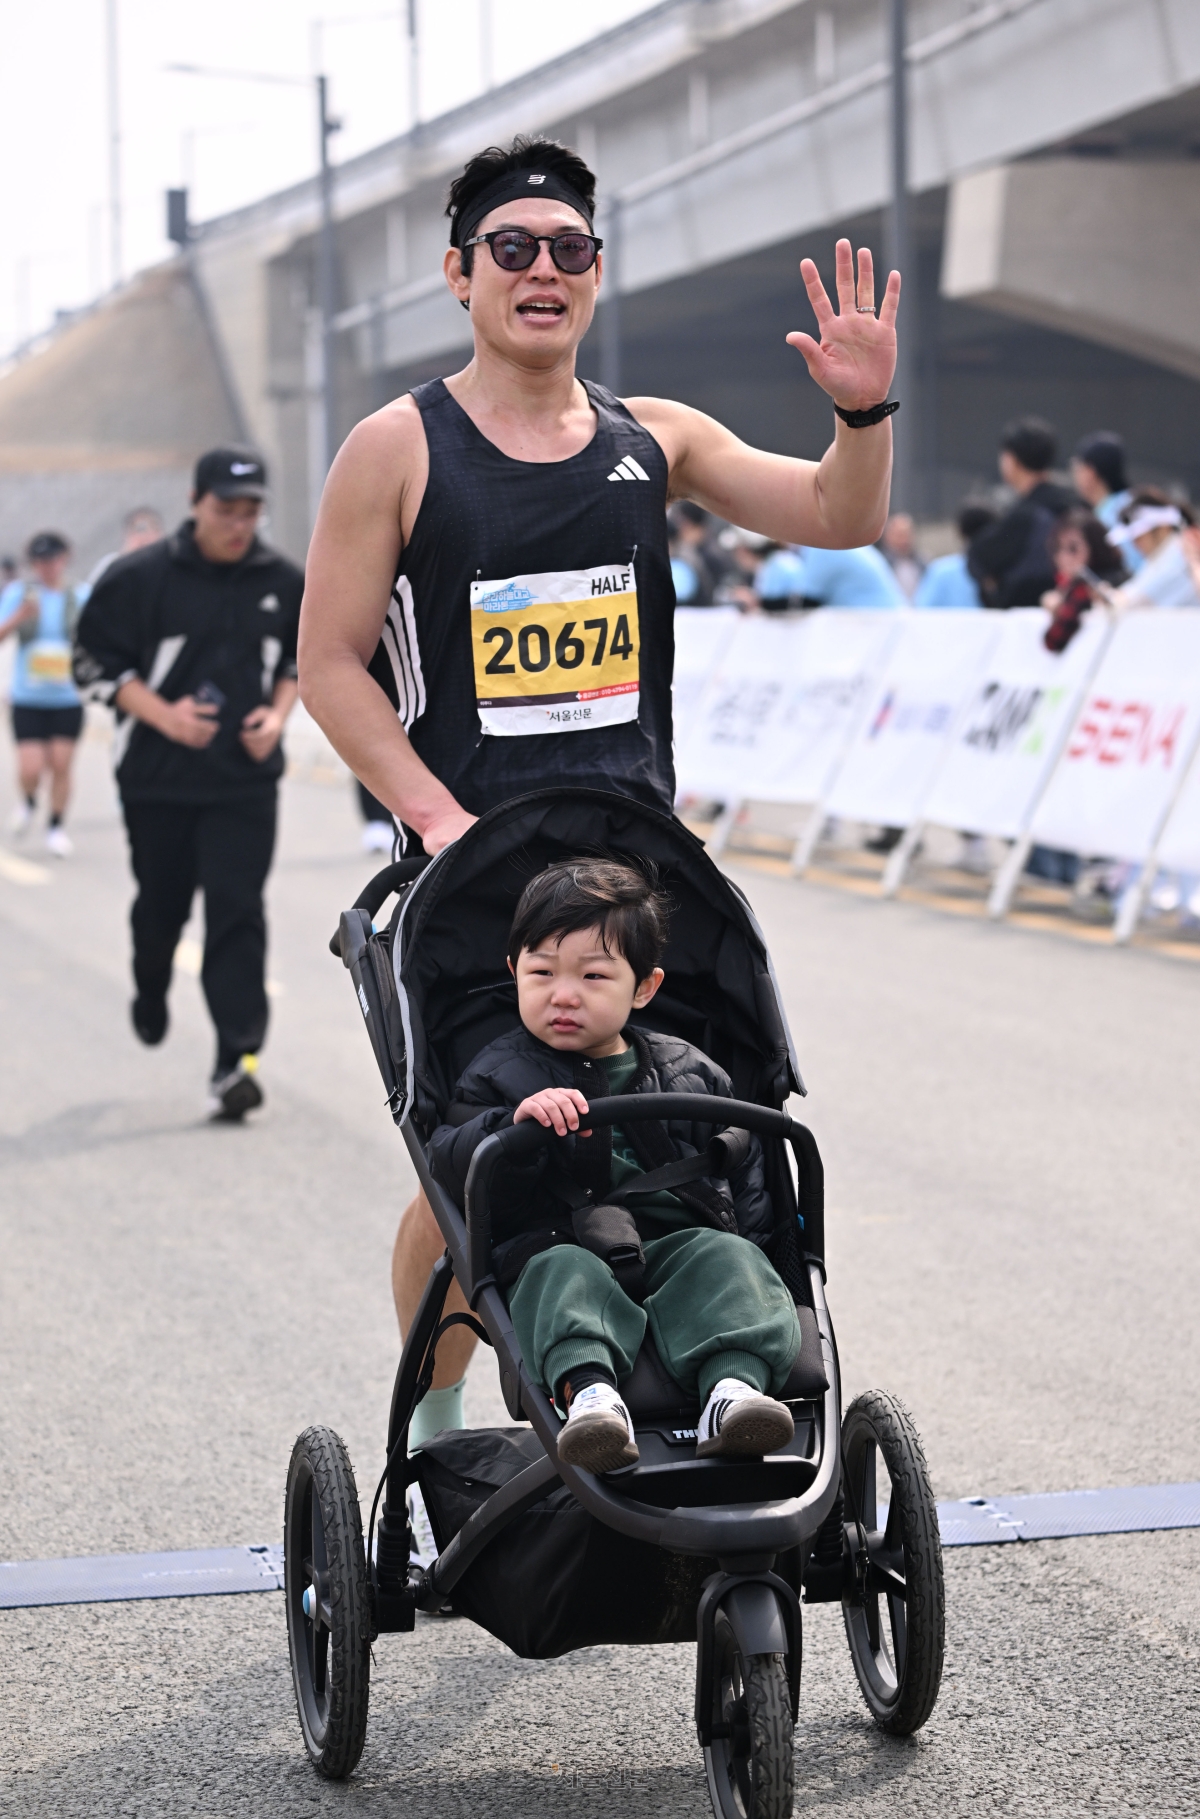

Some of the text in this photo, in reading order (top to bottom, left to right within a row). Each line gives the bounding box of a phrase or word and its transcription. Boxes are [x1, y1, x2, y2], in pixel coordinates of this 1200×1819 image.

[591, 573, 630, 596] HALF
[482, 614, 634, 675] 20674
[549, 707, 592, 723] 서울신문
